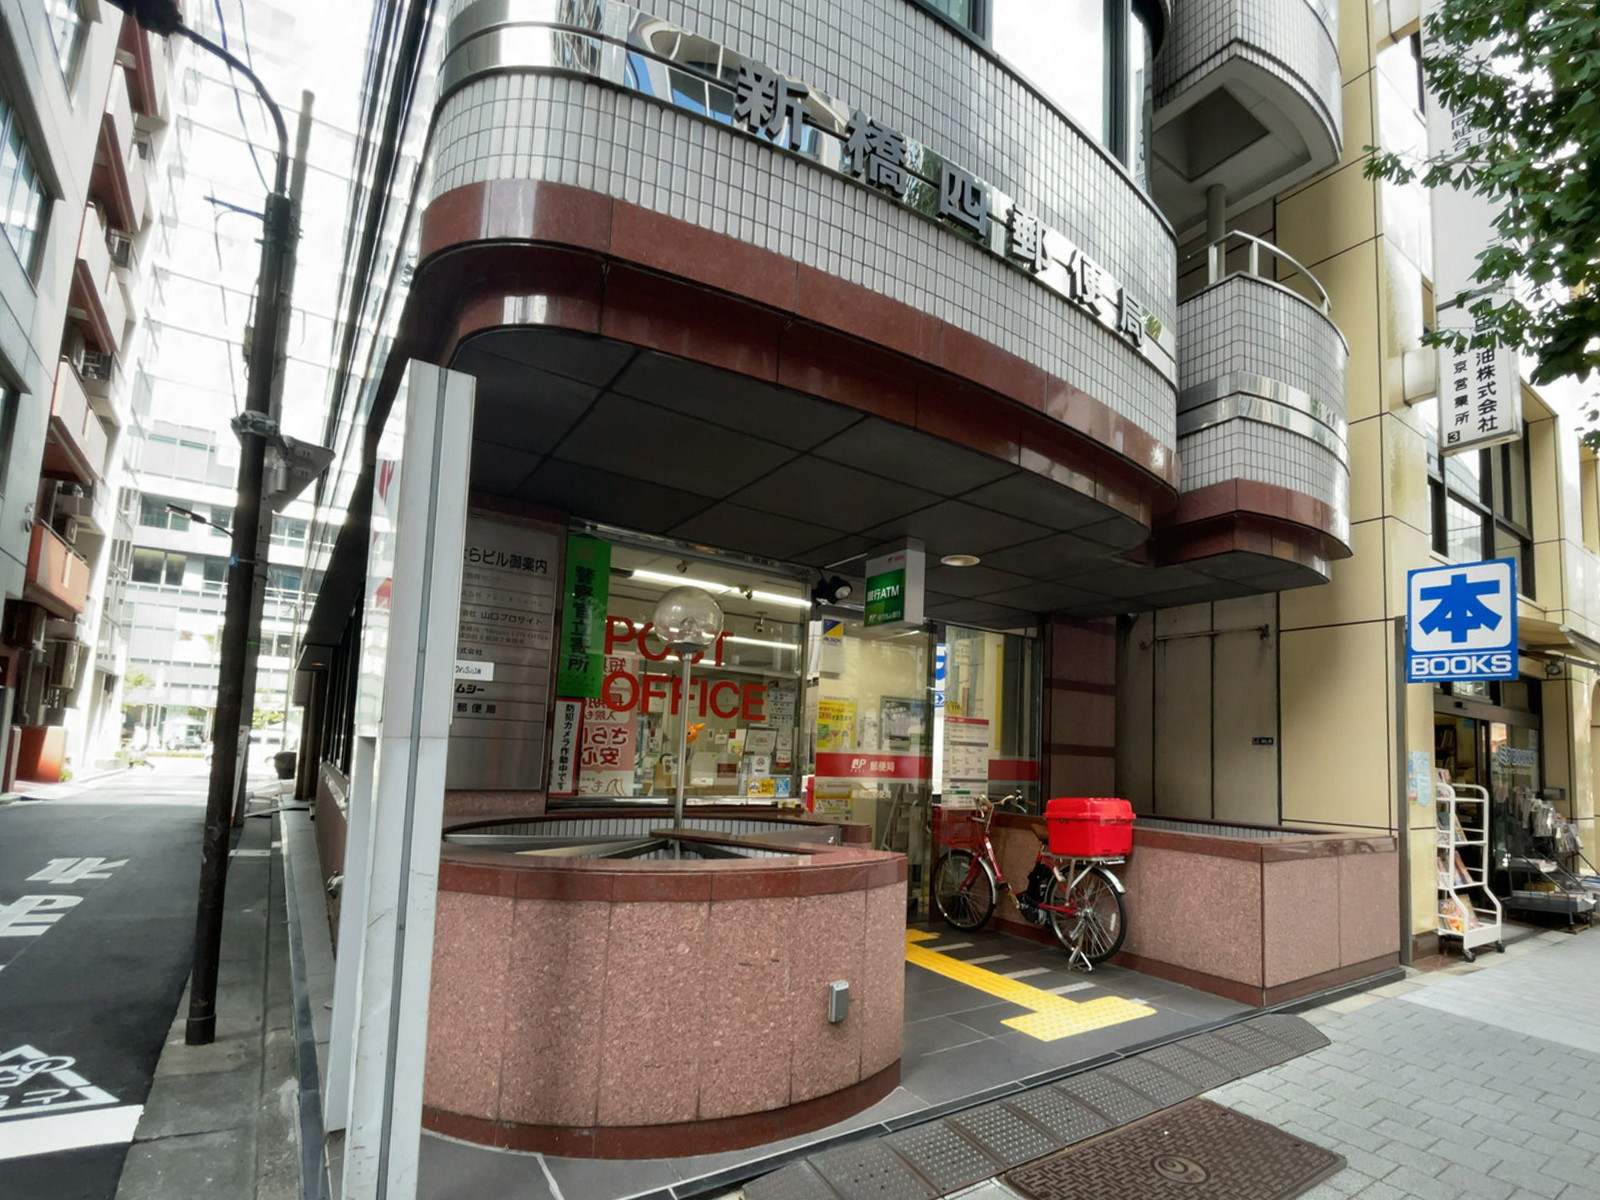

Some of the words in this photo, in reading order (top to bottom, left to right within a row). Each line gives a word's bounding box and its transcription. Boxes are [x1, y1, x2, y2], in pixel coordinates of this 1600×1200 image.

[733, 59, 1147, 350] 新橋四郵便局
[1418, 573, 1503, 643] 本
[454, 683, 485, 694] ムシー
[1411, 653, 1512, 676] BOOKS
[602, 671, 768, 721] OFFICE
[557, 703, 575, 791] 防犯カメラ作動中です
[870, 760, 895, 773] 郵便局
